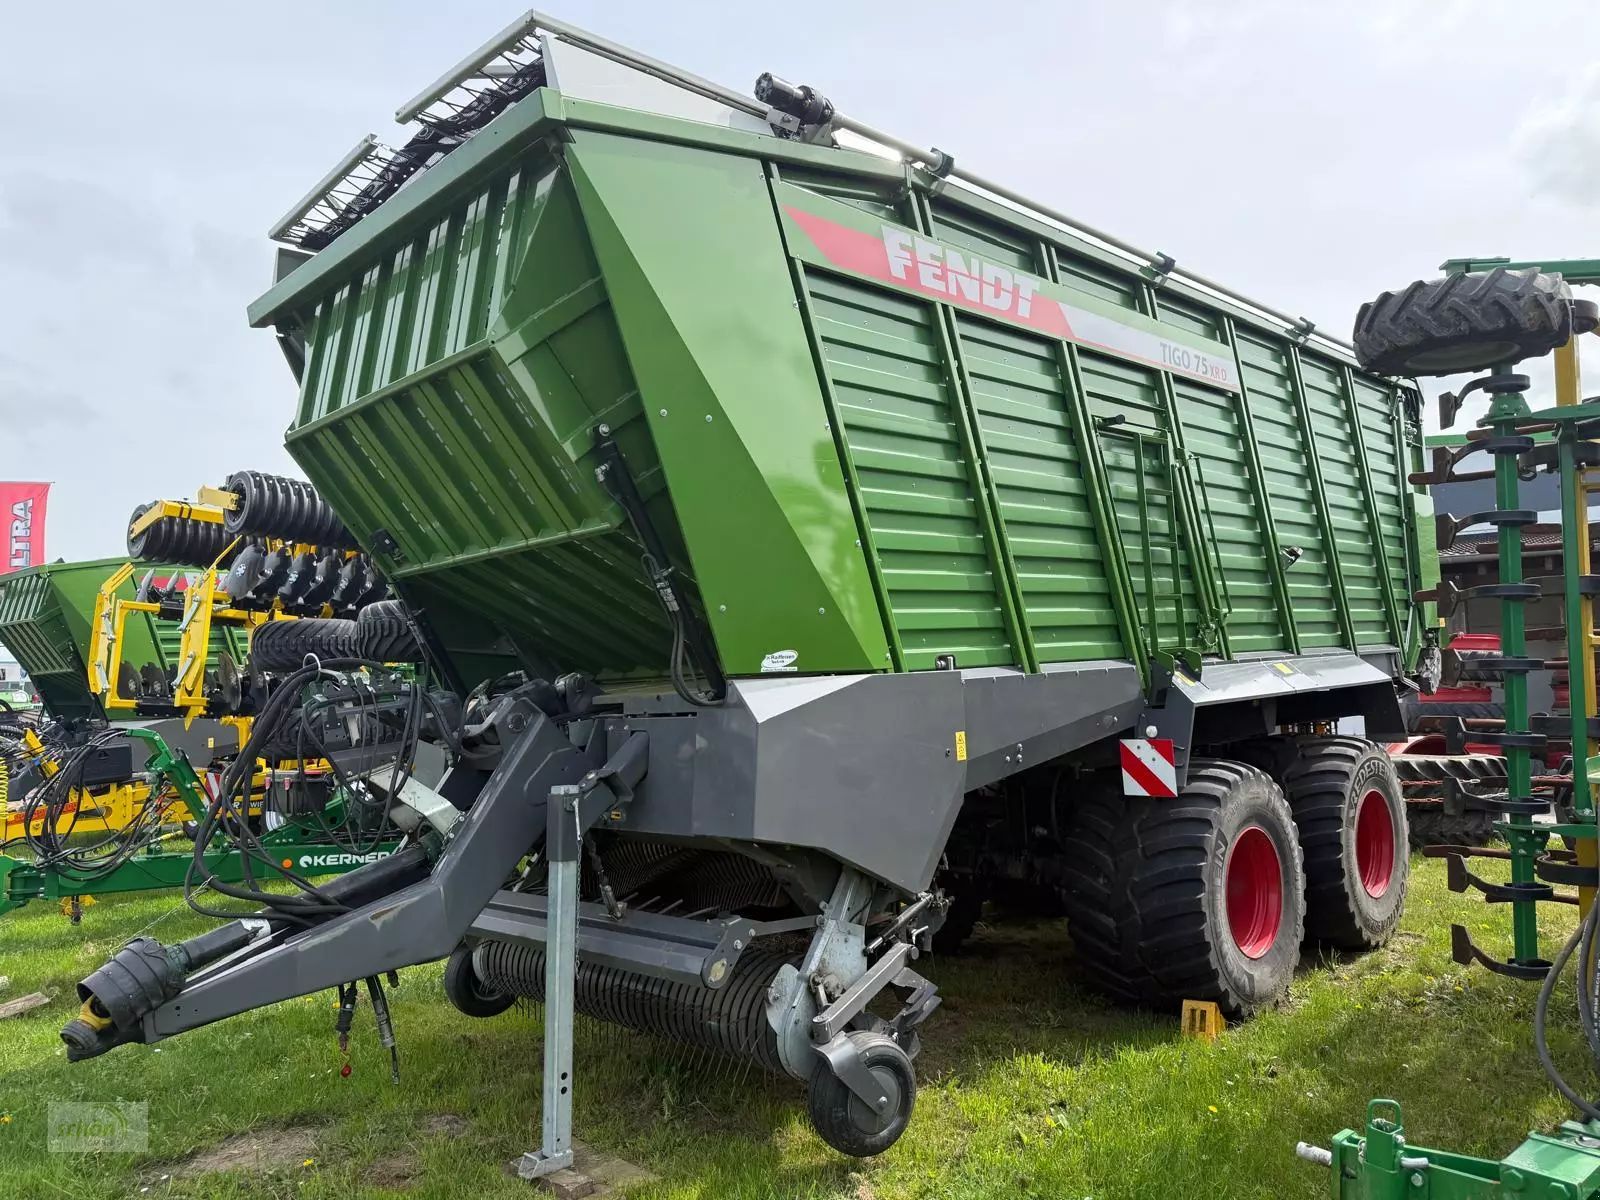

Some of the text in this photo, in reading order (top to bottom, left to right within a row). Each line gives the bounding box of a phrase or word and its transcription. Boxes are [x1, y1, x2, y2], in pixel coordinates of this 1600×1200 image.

[881, 224, 1040, 318] FENDT
[1160, 342, 1190, 370] TIGO
[1194, 354, 1208, 375] 75
[9, 498, 33, 567] LTRA
